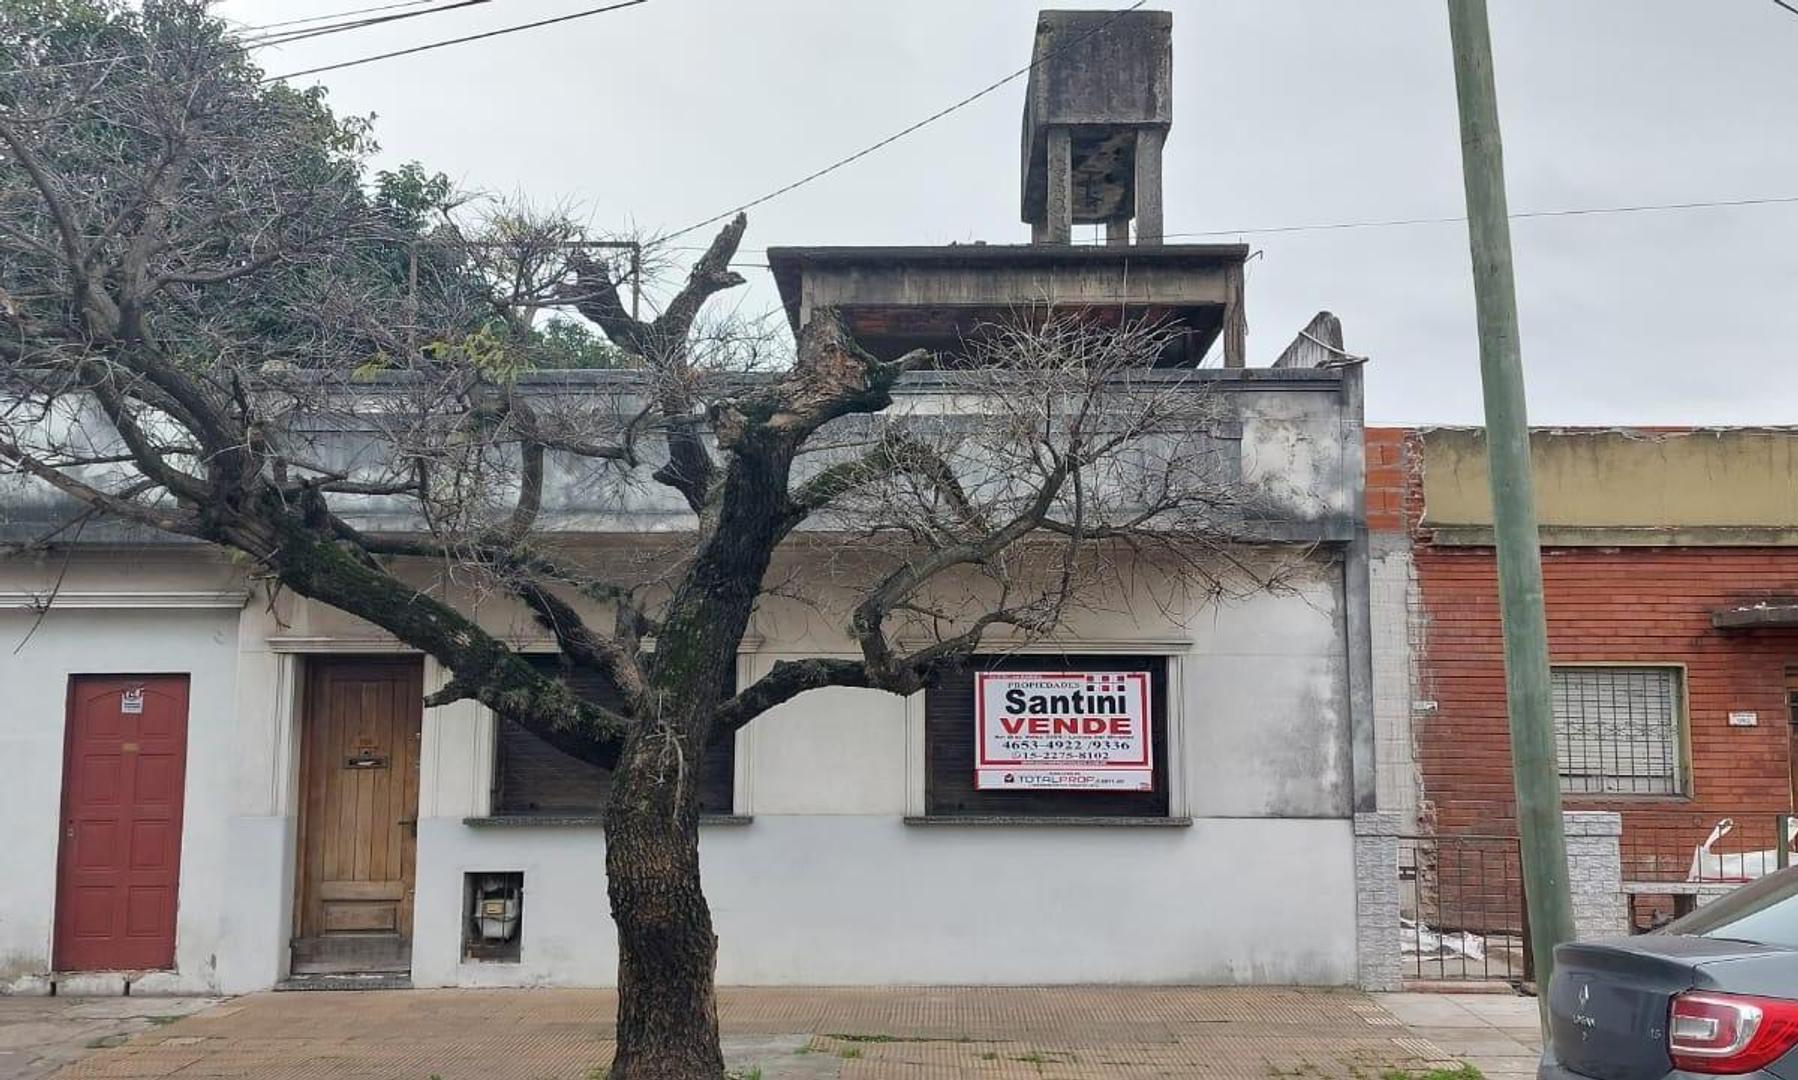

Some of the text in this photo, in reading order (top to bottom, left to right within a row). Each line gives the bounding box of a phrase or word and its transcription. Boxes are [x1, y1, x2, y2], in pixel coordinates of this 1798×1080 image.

[1005, 689, 1126, 715] Santini
[1000, 718, 1132, 735] VENDE
[1002, 740, 1083, 750] 4653-4922
